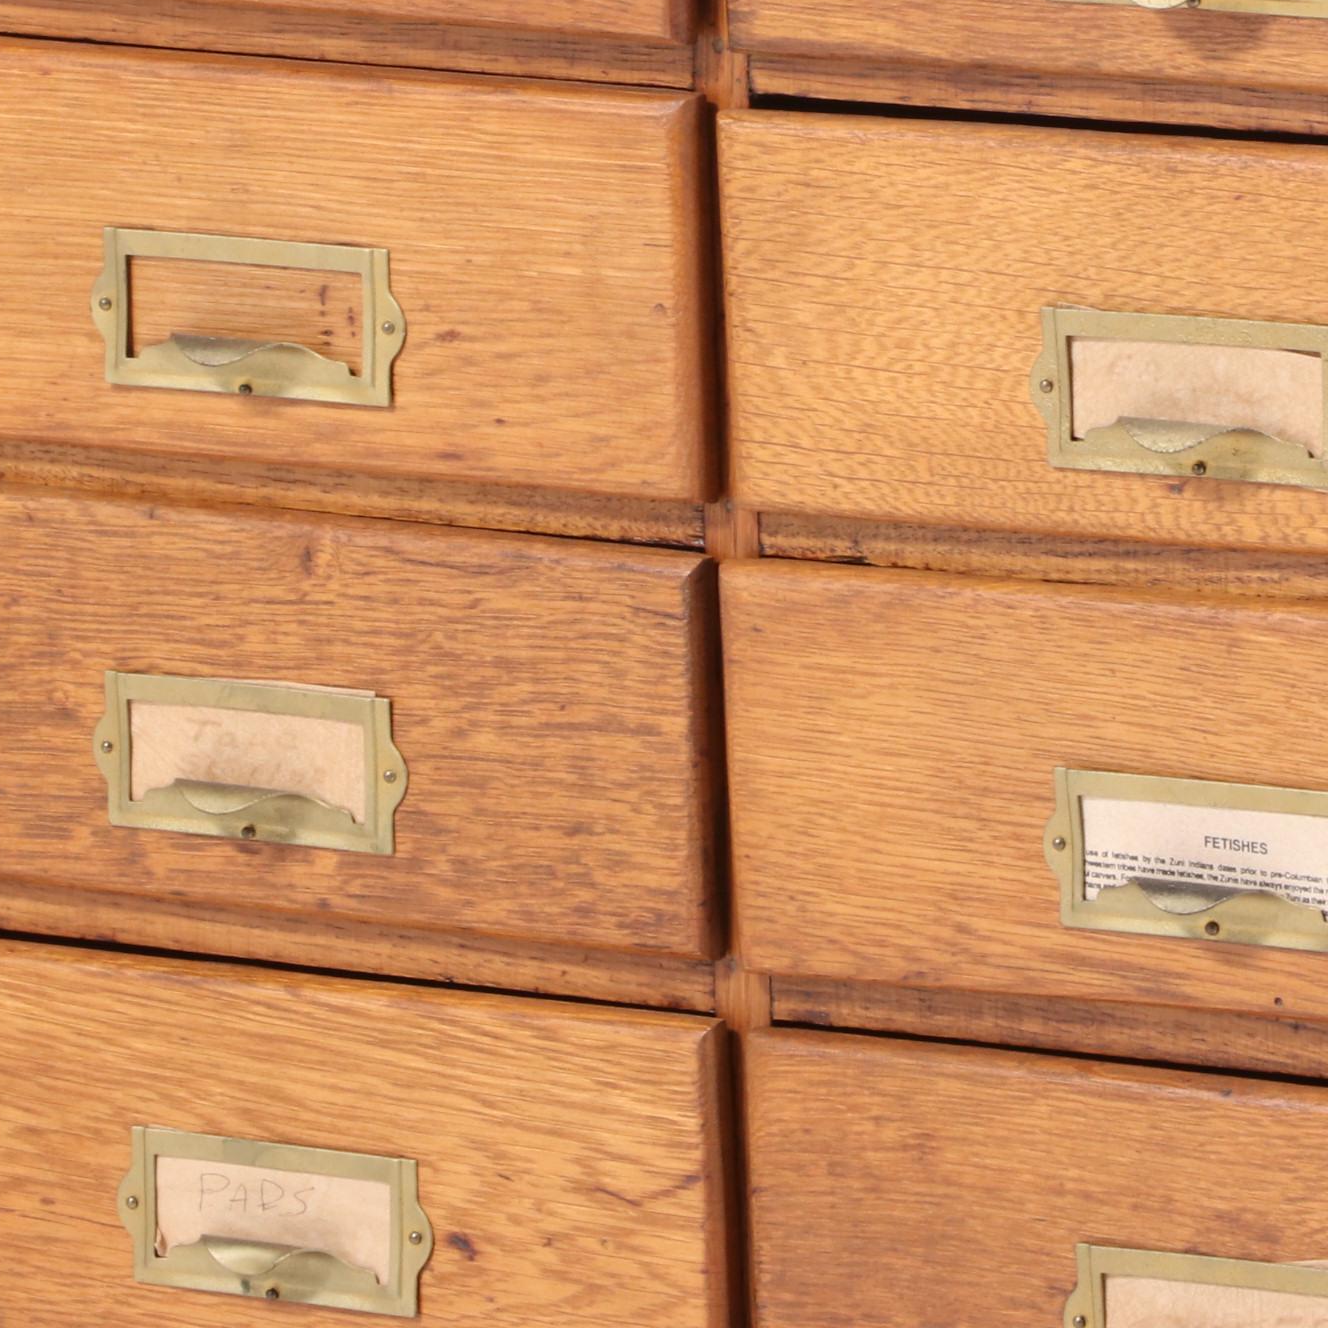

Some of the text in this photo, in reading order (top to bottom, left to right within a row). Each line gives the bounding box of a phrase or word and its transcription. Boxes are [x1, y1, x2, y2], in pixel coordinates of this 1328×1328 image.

[1204, 835, 1268, 855] FETISHES
[1138, 865, 1155, 874] have
[1206, 873, 1219, 882] the
[1240, 877, 1258, 887] have
[1142, 855, 1151, 864] by
[1154, 856, 1166, 864] the
[1240, 867, 1257, 876] prior
[1260, 869, 1268, 878] to
